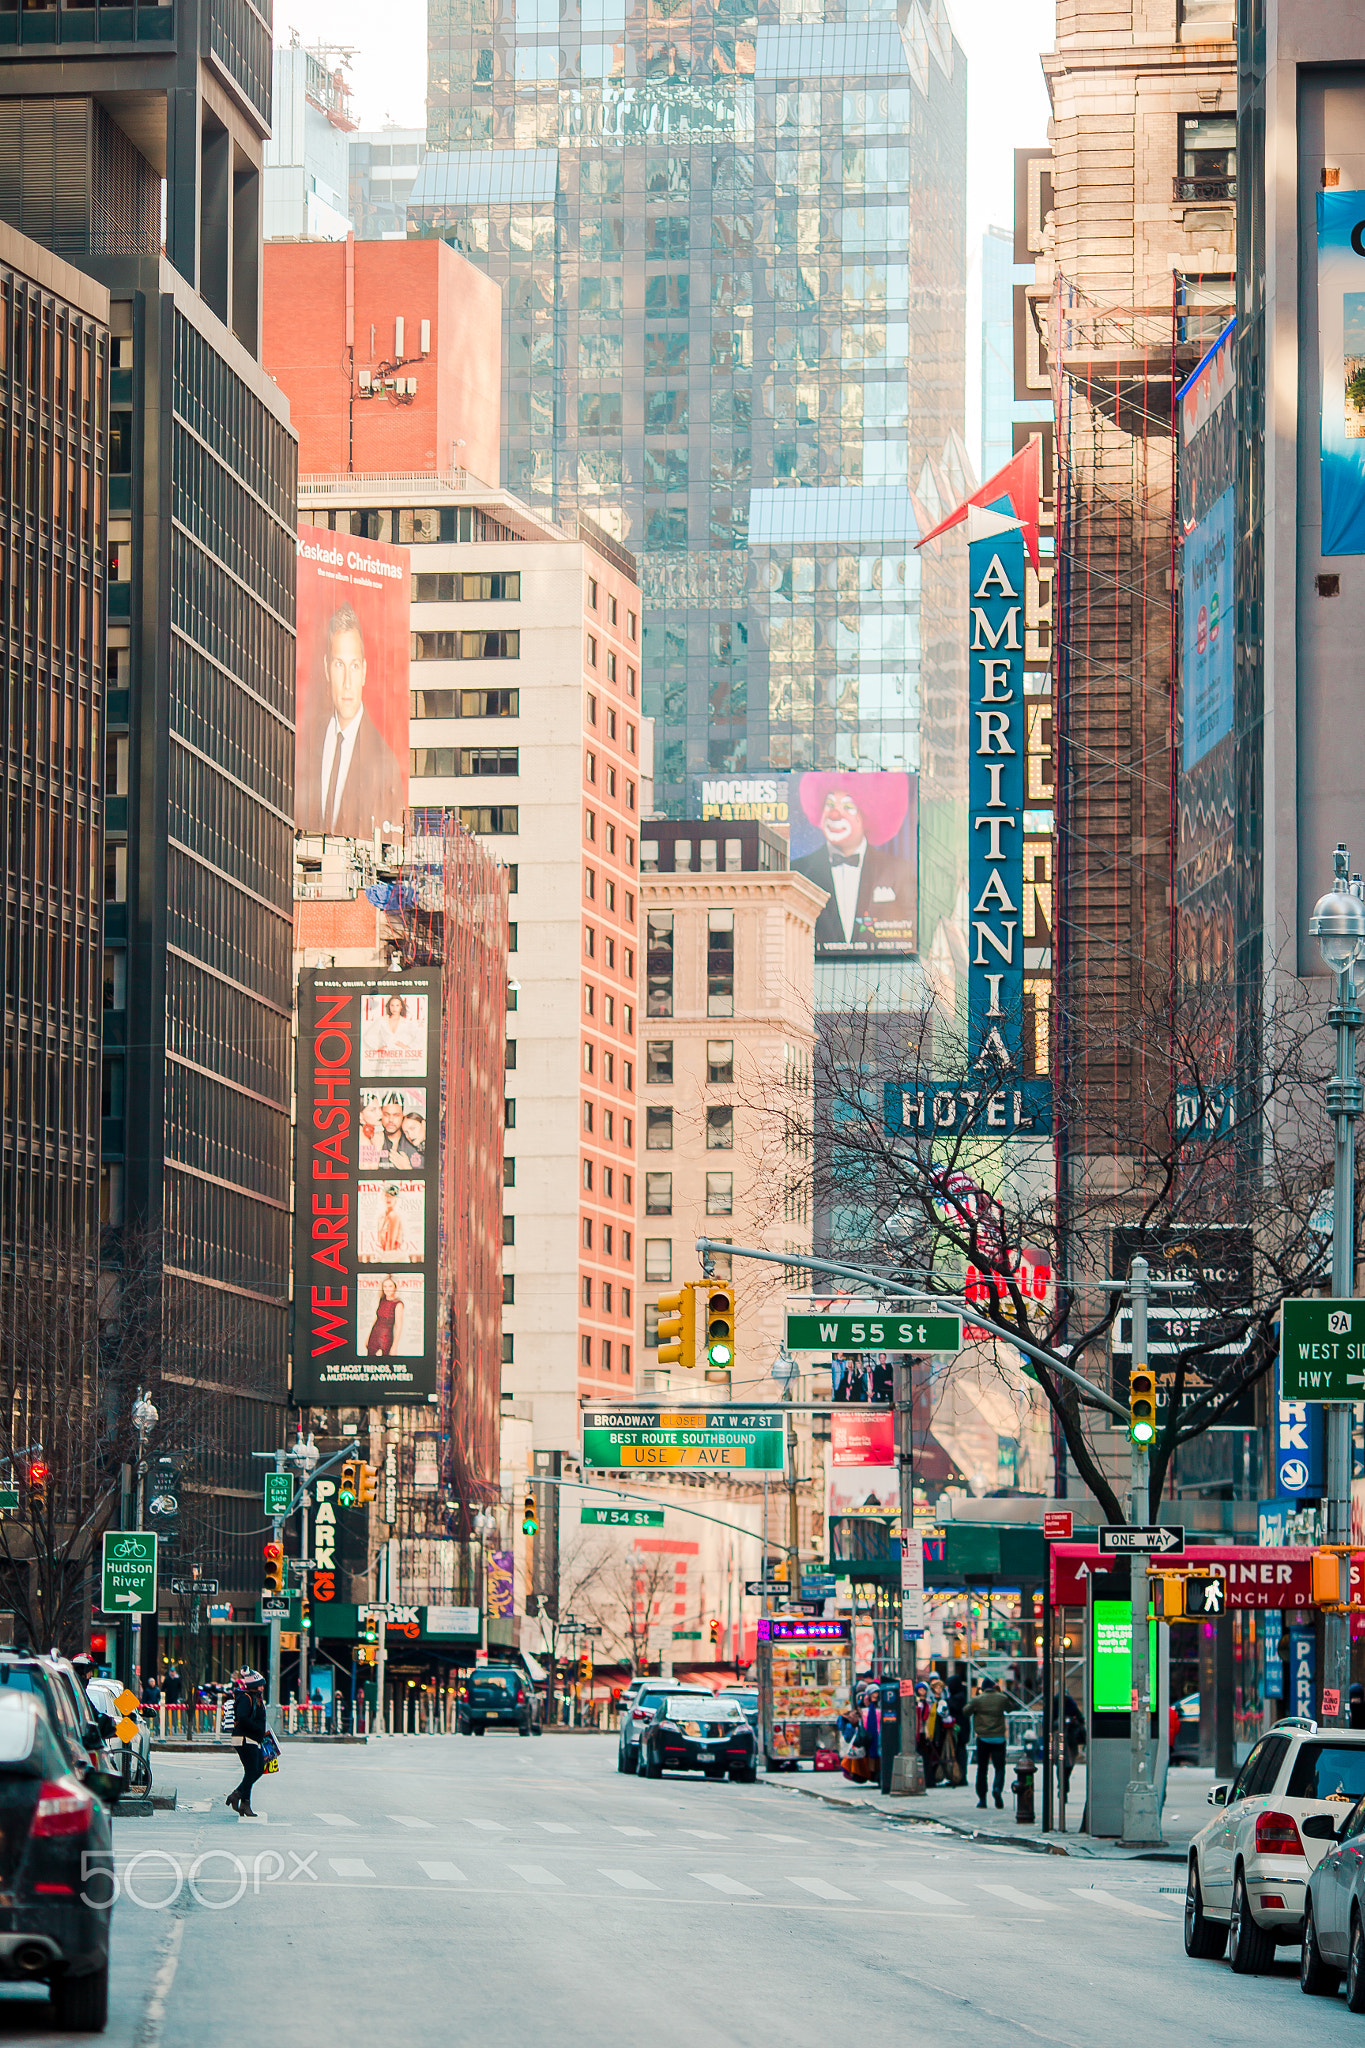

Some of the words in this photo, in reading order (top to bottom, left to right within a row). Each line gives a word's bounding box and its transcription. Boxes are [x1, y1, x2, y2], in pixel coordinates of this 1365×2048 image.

[296, 539, 344, 566] Kaskade
[347, 551, 403, 579] Christmas
[702, 780, 777, 804] NOCHES
[969, 553, 1023, 1072] AMERITANIA
[364, 1050, 404, 1059] SEPTEMBER
[405, 1050, 423, 1059] ISSUE
[313, 995, 353, 1180] FASHION
[902, 1090, 1035, 1127] HOTEL
[311, 1194, 349, 1274] ARE
[311, 1285, 348, 1358] WE
[1331, 1315, 1349, 1331] 9A
[819, 1323, 838, 1342] W
[851, 1323, 885, 1343] 55
[898, 1324, 927, 1343] St
[1298, 1344, 1340, 1359] WEST
[326, 1365, 339, 1373] THE
[341, 1365, 362, 1373] MOST
[1298, 1371, 1332, 1387] HWY
[594, 1416, 655, 1426] BROADWAY
[662, 1416, 704, 1426] CLOSED
[711, 1416, 725, 1426] AT
[729, 1417, 740, 1426] W
[741, 1417, 755, 1427] 47
[759, 1417, 773, 1427] ST
[610, 1434, 637, 1444] BEST
[642, 1434, 677, 1444] ROUTE
[682, 1434, 756, 1444] SOUTHBOUND
[635, 1449, 667, 1463] USE
[677, 1450, 687, 1463] 7
[697, 1450, 730, 1463] AVE
[315, 1480, 337, 1570] PARK
[596, 1511, 608, 1523] W
[610, 1512, 629, 1524] 54
[634, 1513, 650, 1525] St
[1111, 1535, 1136, 1545] ONE
[1146, 1535, 1171, 1545] WAY
[107, 1562, 153, 1574] Hudson
[1209, 1563, 1292, 1584] DINER
[112, 1576, 146, 1587] River
[1296, 1641, 1312, 1717] PARK
